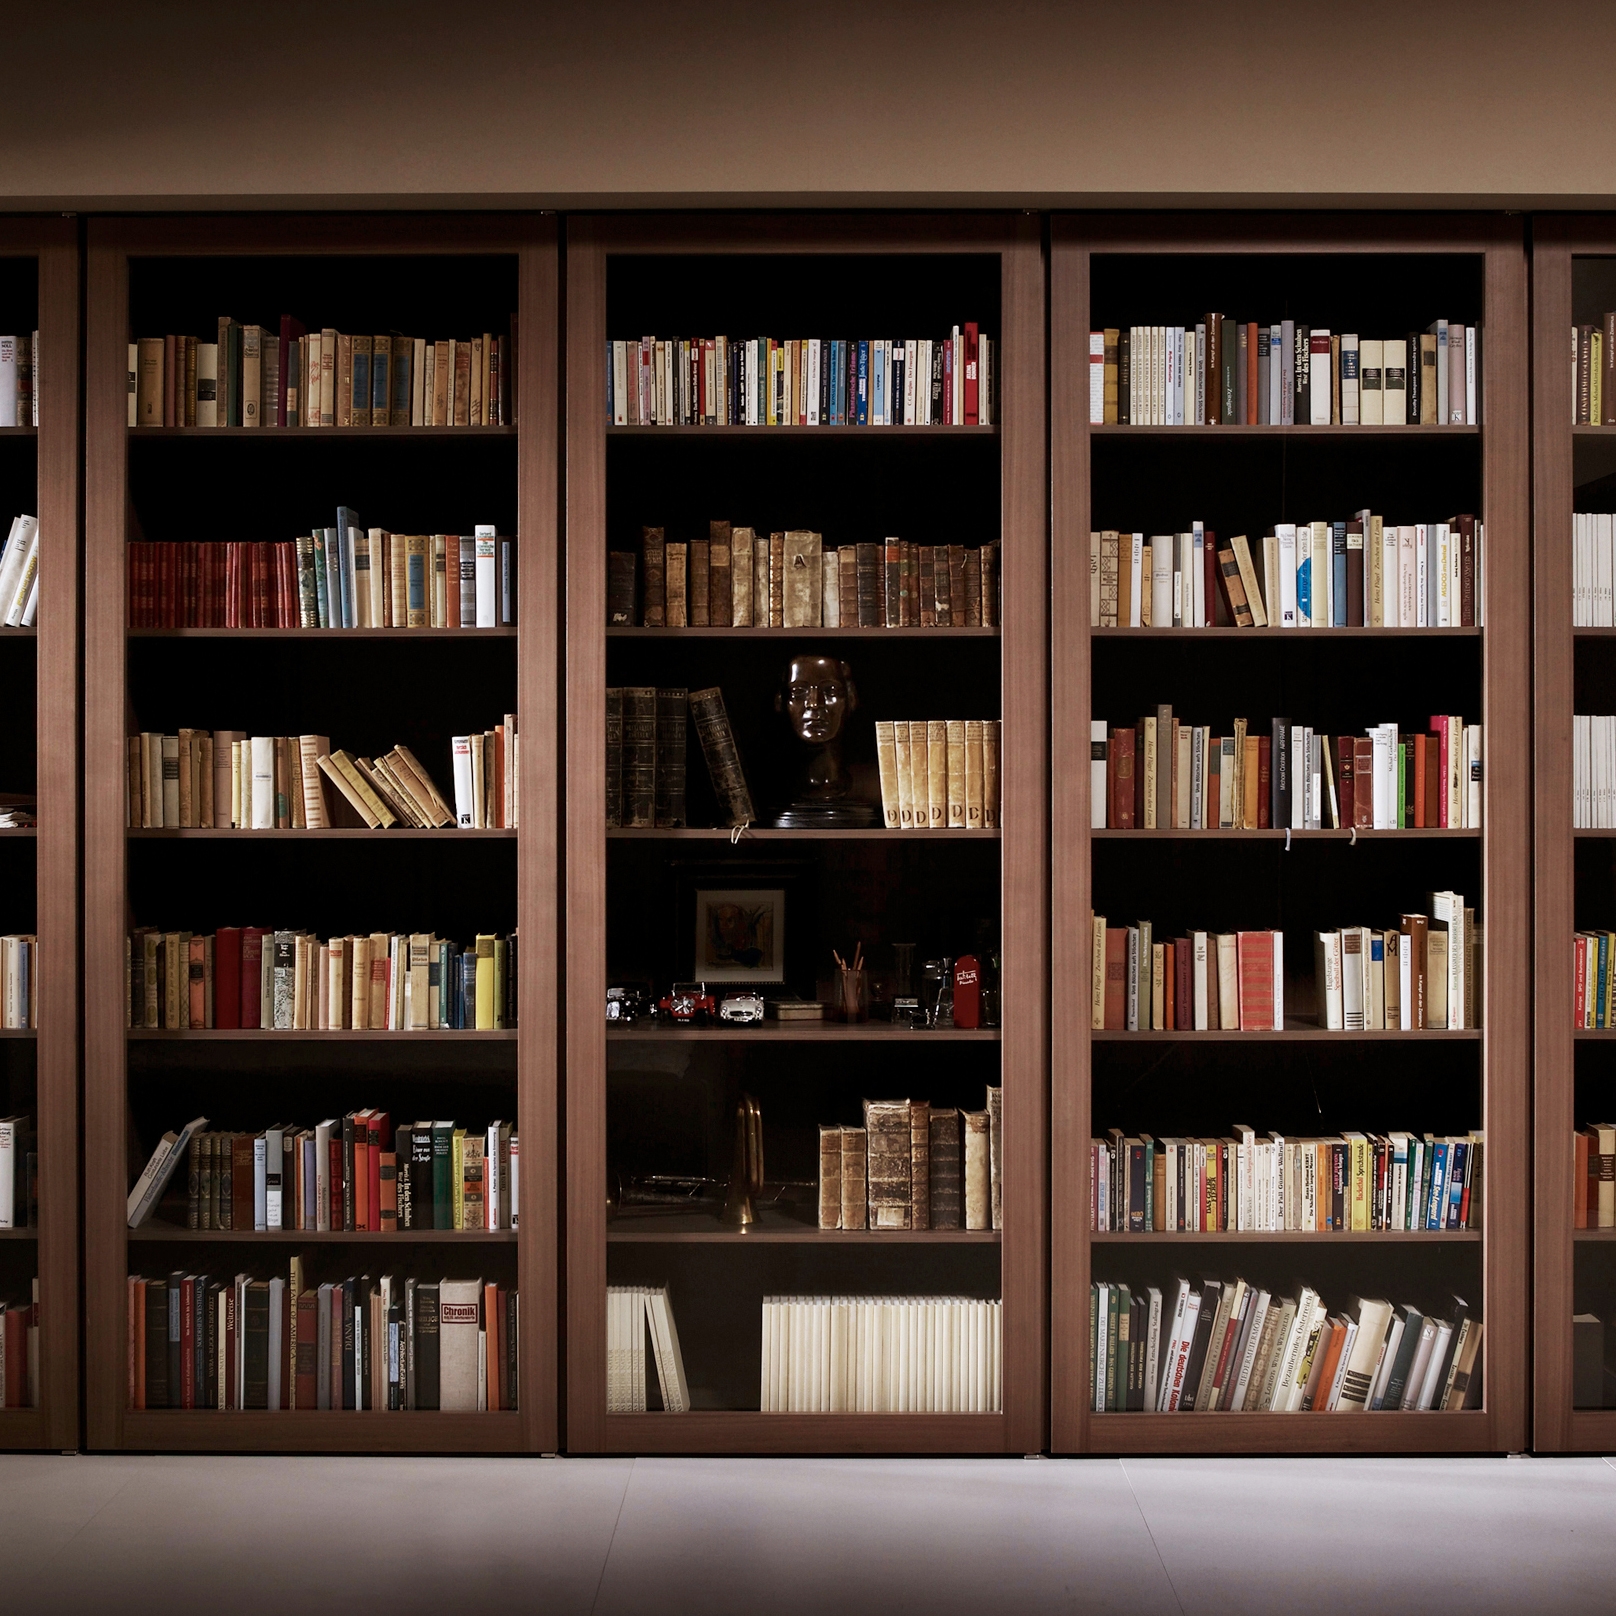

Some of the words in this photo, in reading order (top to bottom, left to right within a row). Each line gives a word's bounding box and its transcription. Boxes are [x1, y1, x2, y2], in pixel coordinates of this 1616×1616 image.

[444, 1306, 475, 1316] Chronik
[1179, 1341, 1189, 1353] Die
[1239, 1309, 1264, 1387] BIEDERMEIERMÖBEL
[1173, 1354, 1187, 1389] deutschen
